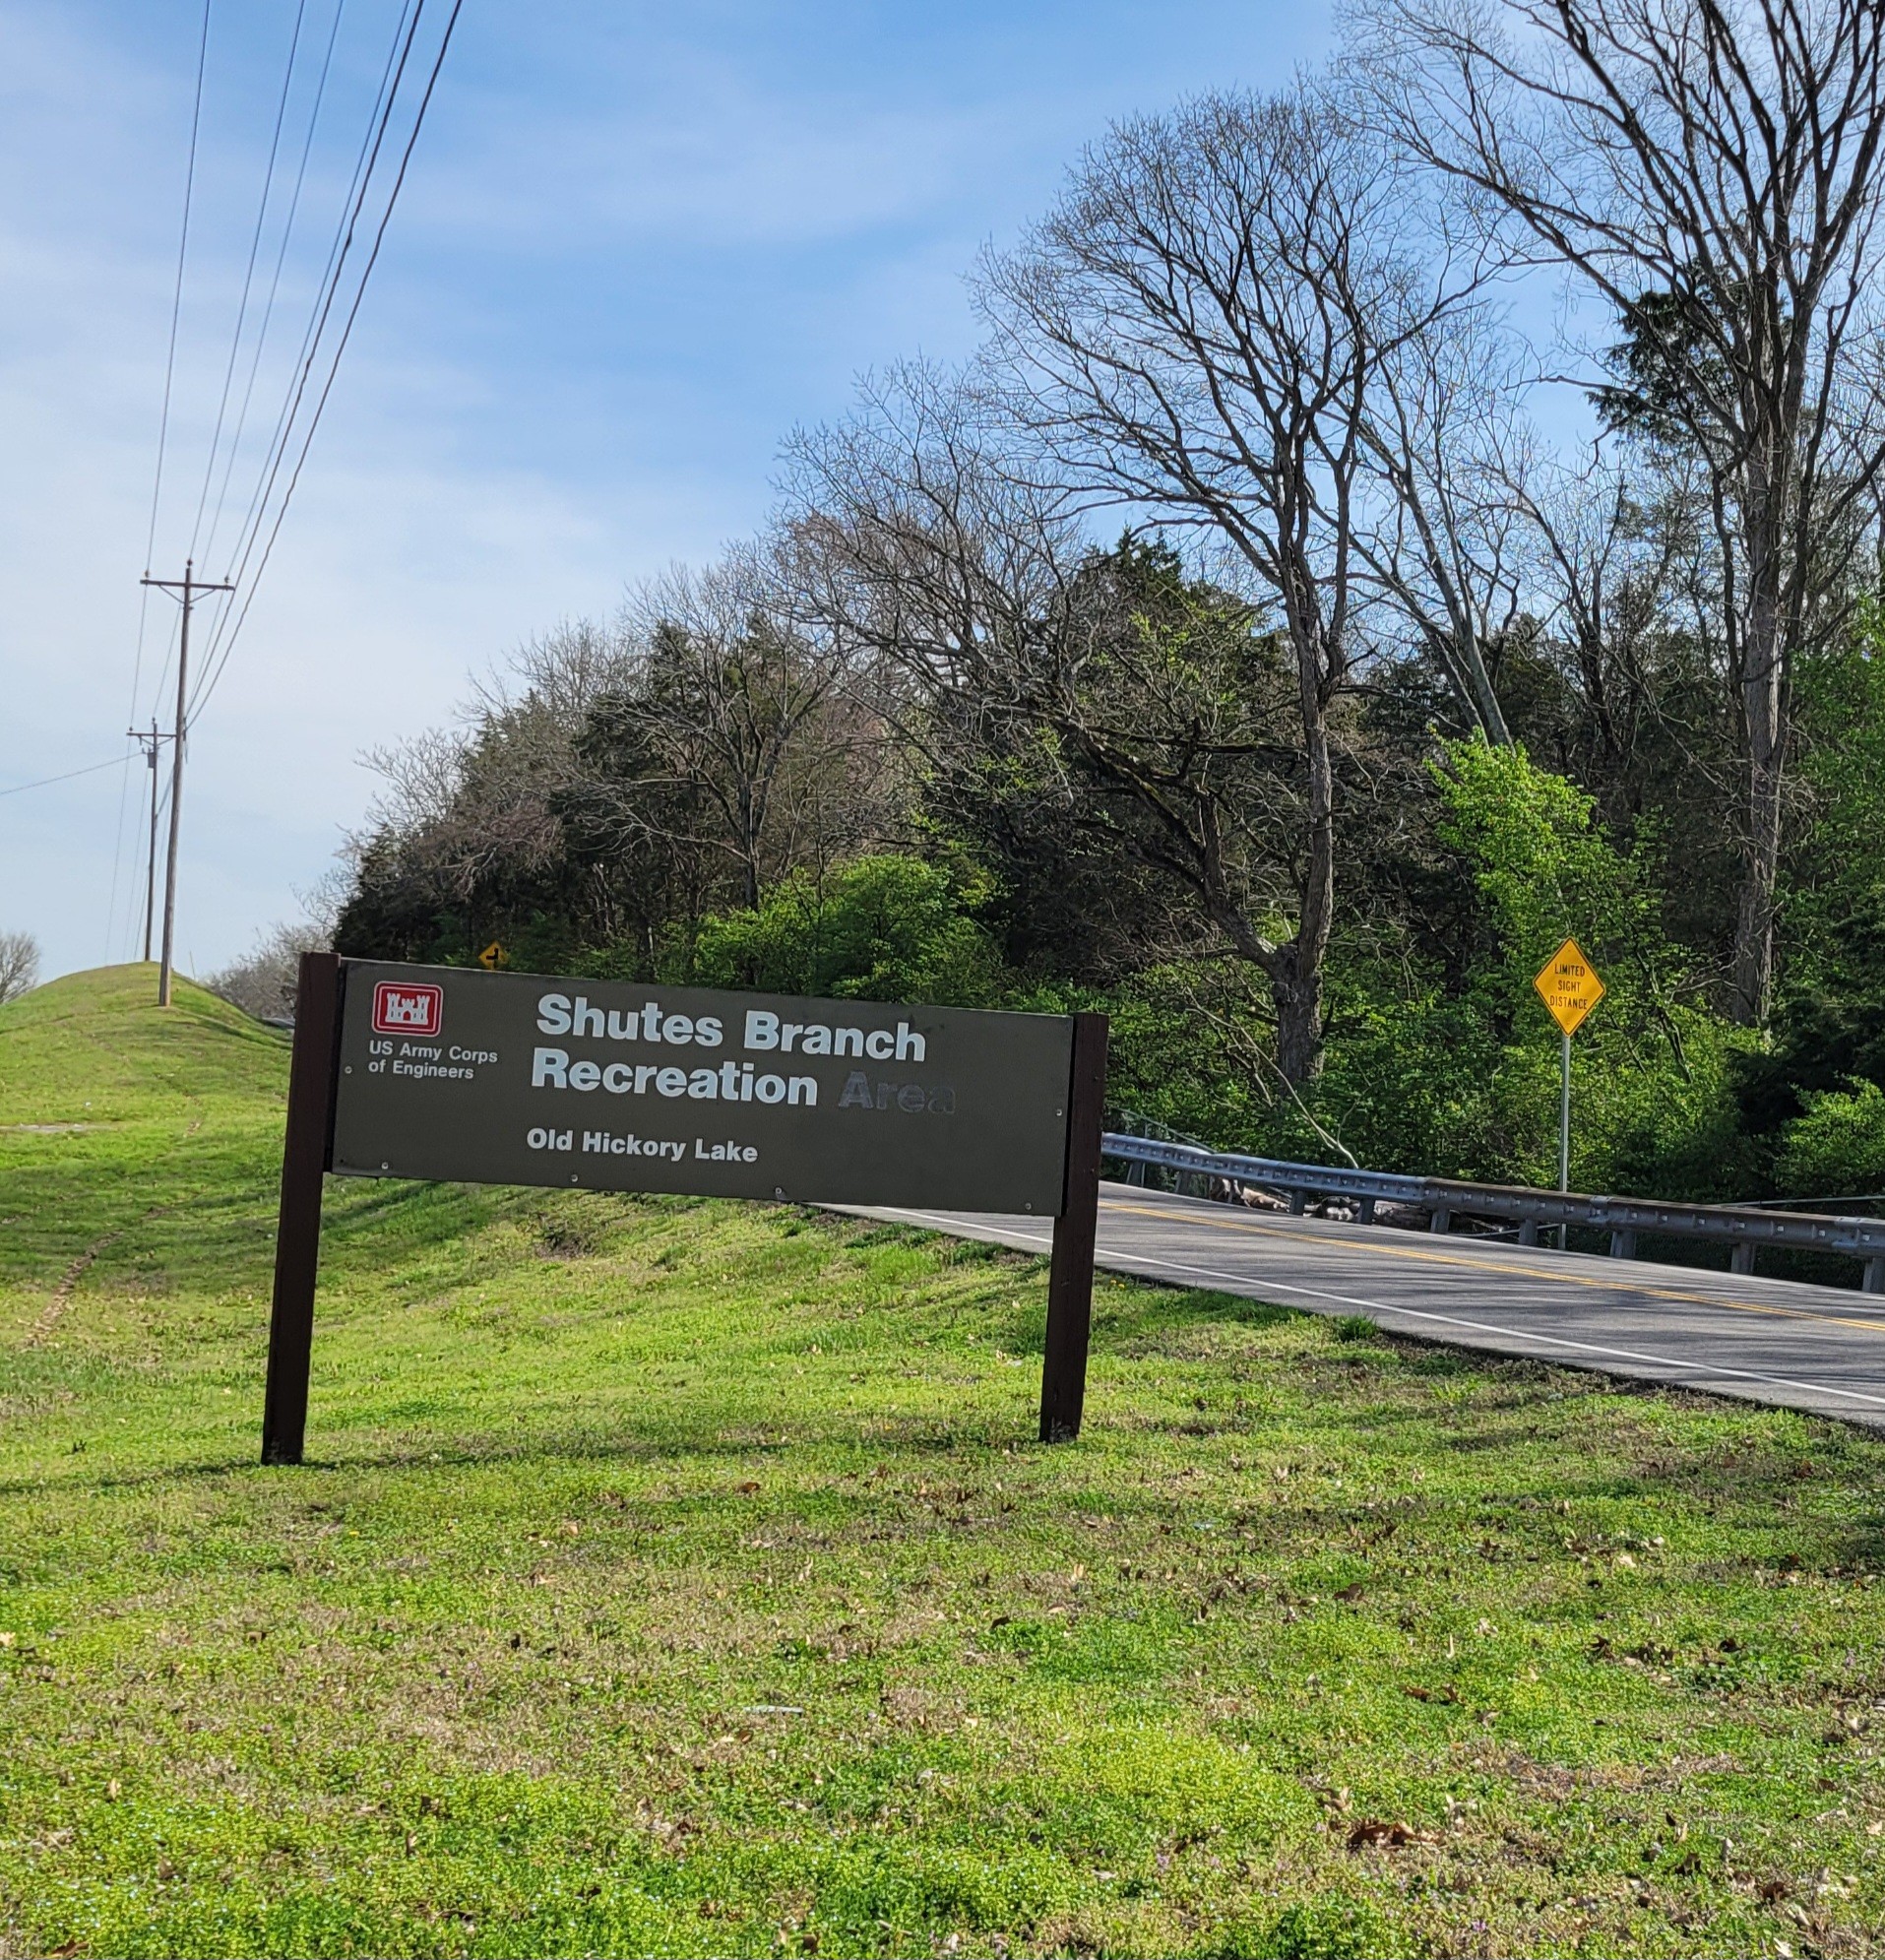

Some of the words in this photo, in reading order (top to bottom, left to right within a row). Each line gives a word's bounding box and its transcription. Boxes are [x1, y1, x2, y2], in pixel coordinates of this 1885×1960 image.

[1555, 964, 1585, 977] LIMITED
[1557, 980, 1581, 992] SIGHT
[1549, 995, 1588, 1009] DISTANCE
[536, 993, 723, 1046] Shutes
[743, 1010, 925, 1061] Branch
[369, 1040, 393, 1055] US
[400, 1043, 442, 1061] Army
[449, 1045, 498, 1064] Corps
[368, 1059, 386, 1073] of
[393, 1060, 474, 1079] Engineers
[532, 1047, 818, 1106] Recreation
[838, 1071, 957, 1114] Area
[527, 1127, 572, 1151] Old
[582, 1132, 686, 1162] Hickory
[695, 1138, 758, 1163] Lake
